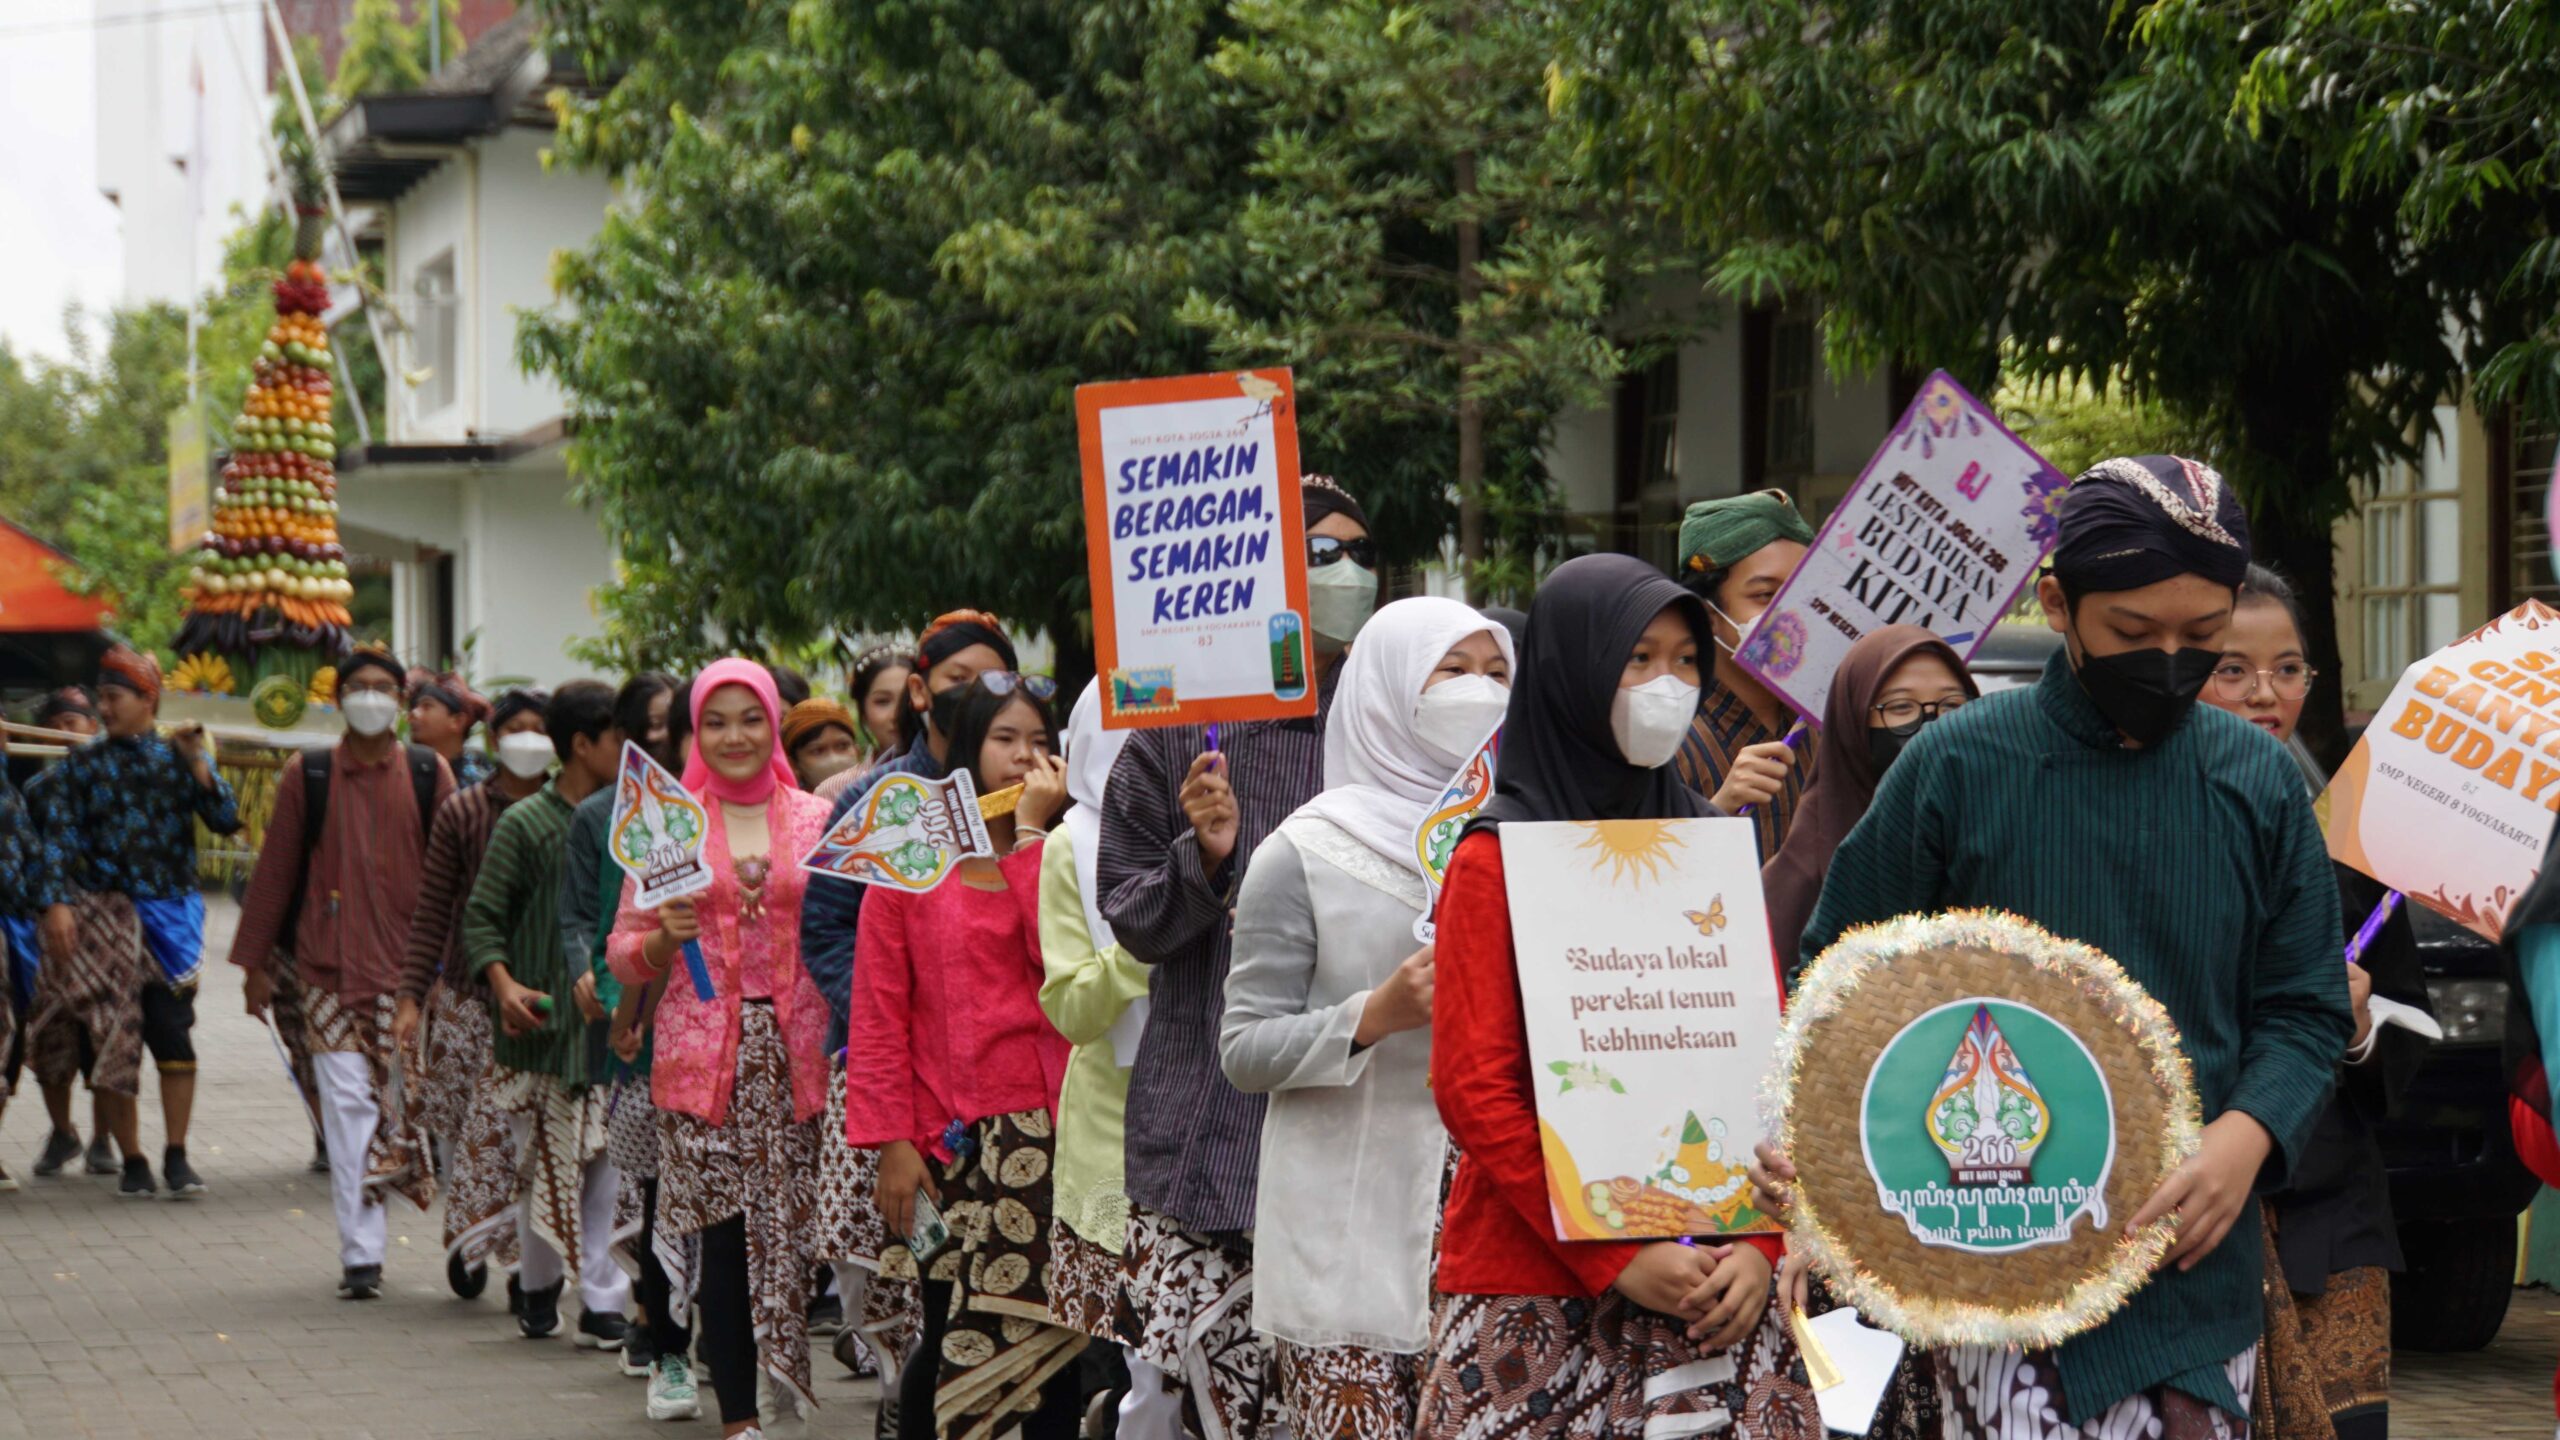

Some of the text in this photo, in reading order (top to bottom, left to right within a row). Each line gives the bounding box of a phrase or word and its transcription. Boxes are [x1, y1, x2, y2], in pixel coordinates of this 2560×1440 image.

[1117, 442, 1258, 494] SEMAKIN
[1114, 485, 1274, 540] BERAGAM,
[1891, 471, 1919, 496] HUT
[1914, 490, 1949, 524] KOTA
[1945, 519, 1987, 556] JOGJA
[1127, 530, 1270, 582] SEMAKIN
[1865, 482, 2003, 602] LESTARIKAN
[1855, 515, 1971, 623] BUDAYA
[1152, 577, 1255, 625] KEREN
[1810, 597, 1860, 641] SMP NEGERI
[2468, 659, 2560, 718] CIN
[917, 799, 955, 849] 266
[2376, 762, 2540, 851] SMP NEGERI 8 YOGYAKARTA
[645, 840, 686, 876] 266
[1566, 944, 1729, 978] Budaya lokal
[1570, 985, 1737, 1020] perekat tenun
[1579, 1024, 1737, 1053] kebhinekaan
[1958, 1168, 2023, 1181] HUT KOTA JOGJA
[1962, 1135, 2017, 1168] 266
[1966, 1225, 2012, 1243] pulih
